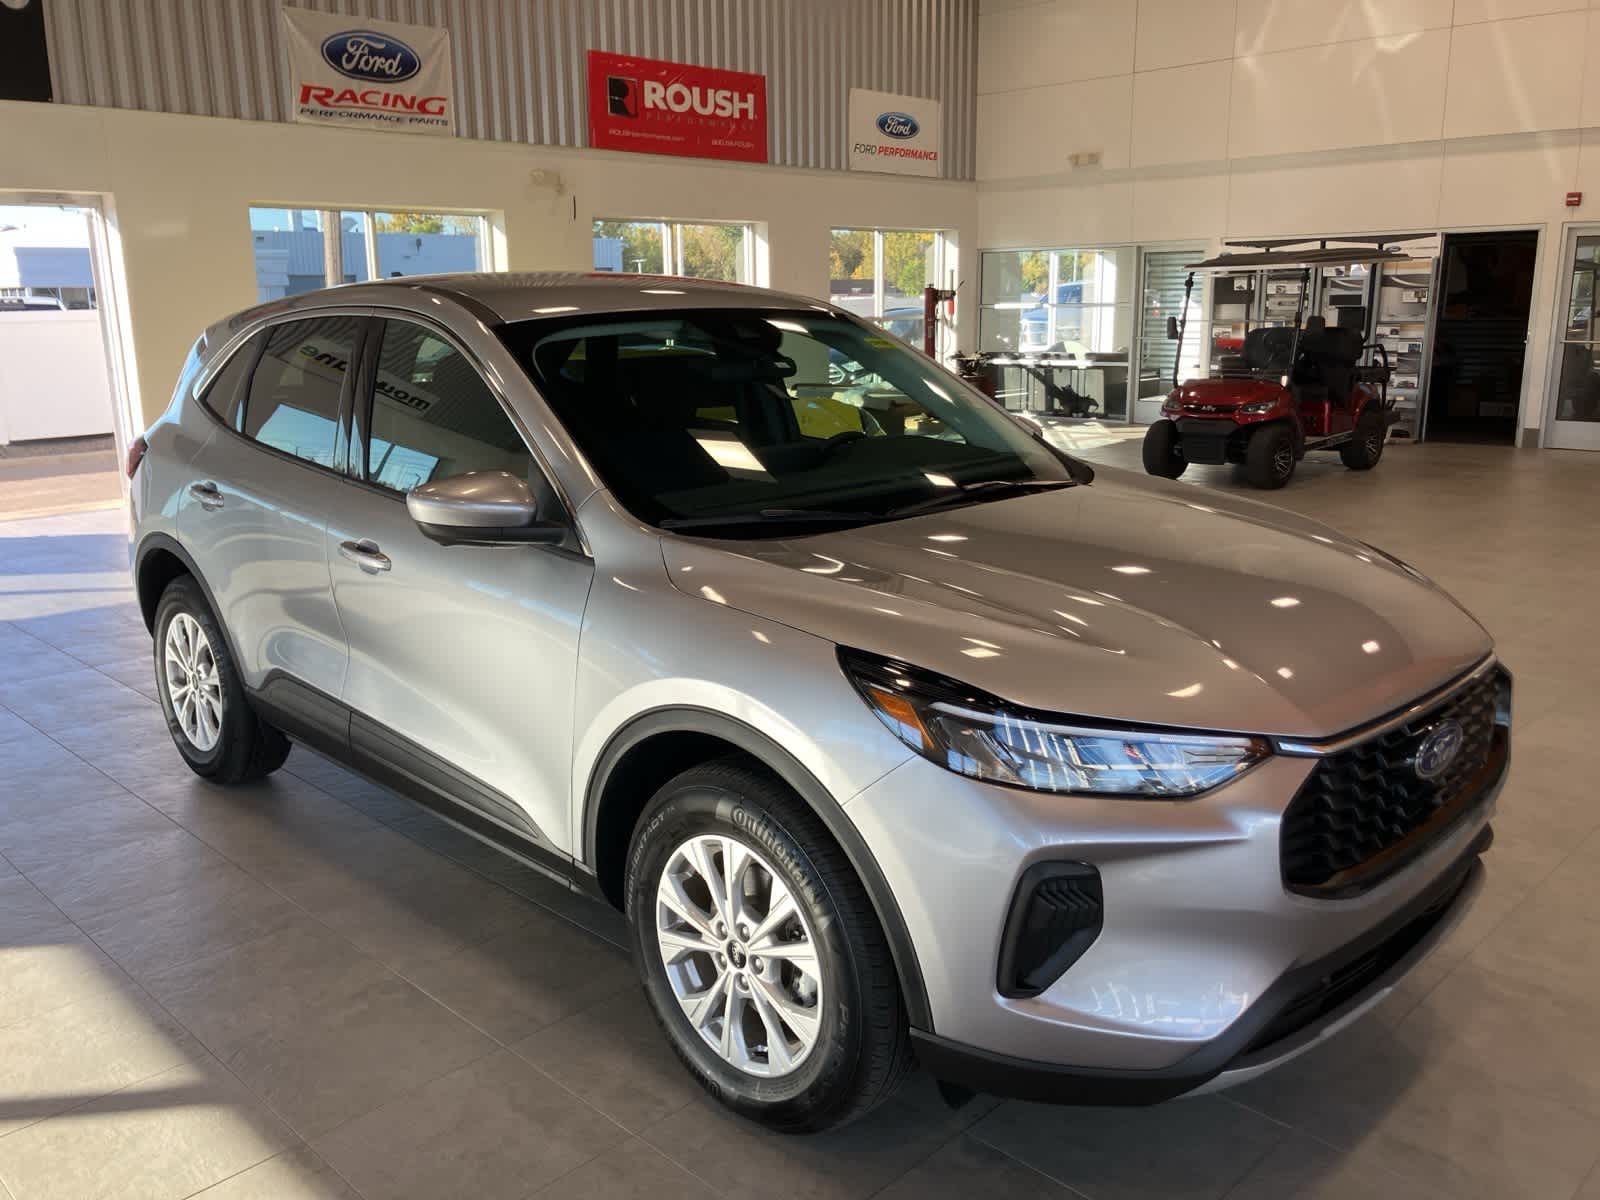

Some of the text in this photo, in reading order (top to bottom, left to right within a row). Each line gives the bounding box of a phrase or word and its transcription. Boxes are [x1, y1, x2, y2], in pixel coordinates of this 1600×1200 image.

[341, 37, 402, 76] Ford
[300, 84, 448, 116] RACING
[643, 80, 754, 121] ROUSH
[300, 108, 449, 127] PERFORMANCE PARTS
[884, 116, 912, 136] Ford
[853, 143, 938, 161] FORD PERFORMANCE
